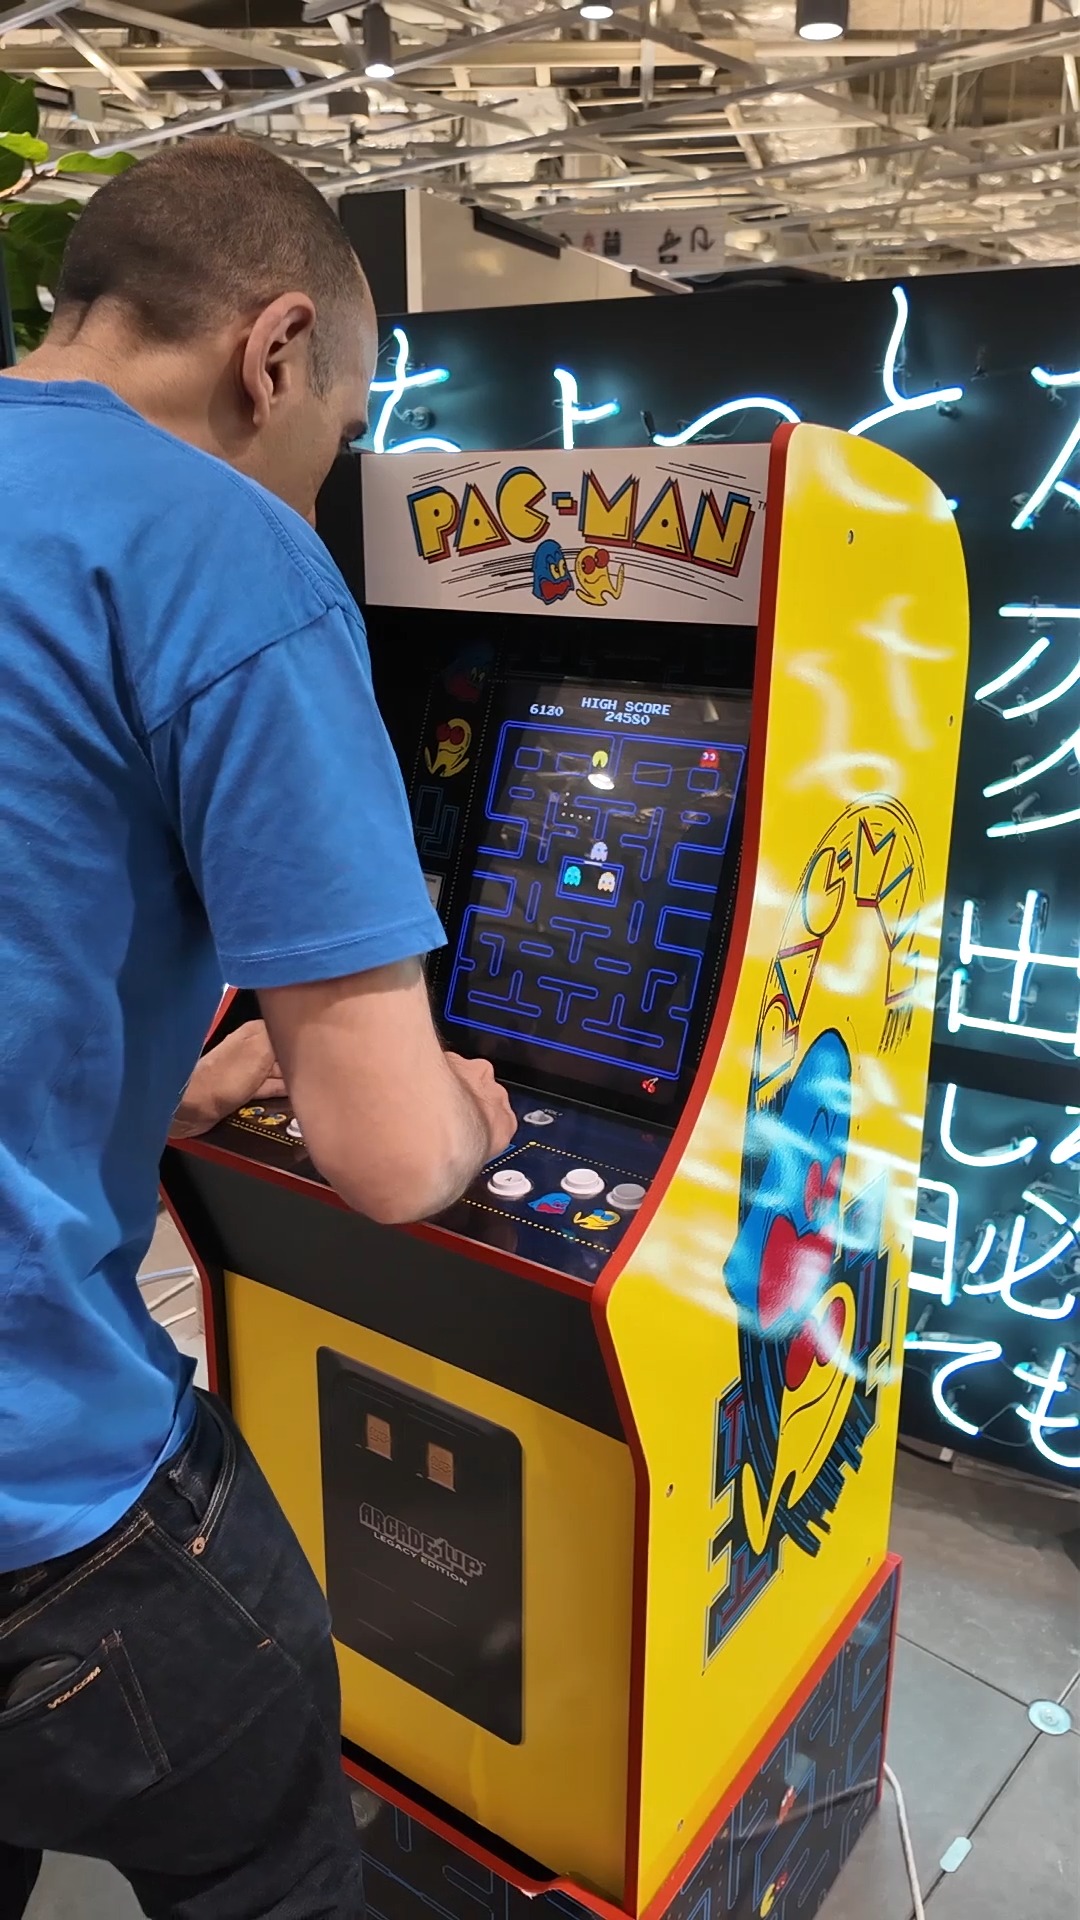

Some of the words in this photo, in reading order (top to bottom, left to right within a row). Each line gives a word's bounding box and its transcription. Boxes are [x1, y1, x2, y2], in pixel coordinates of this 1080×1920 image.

[406, 466, 756, 577] PAC-MAN
[581, 697, 617, 710] HIGH
[624, 701, 671, 715] SCORE
[604, 711, 651, 726] 24580
[751, 815, 922, 1094] PAC-MAN
[373, 1531, 417, 1558] LEGACY
[420, 1556, 468, 1586] EDITION
[47, 1666, 102, 1709] VOLCOM
